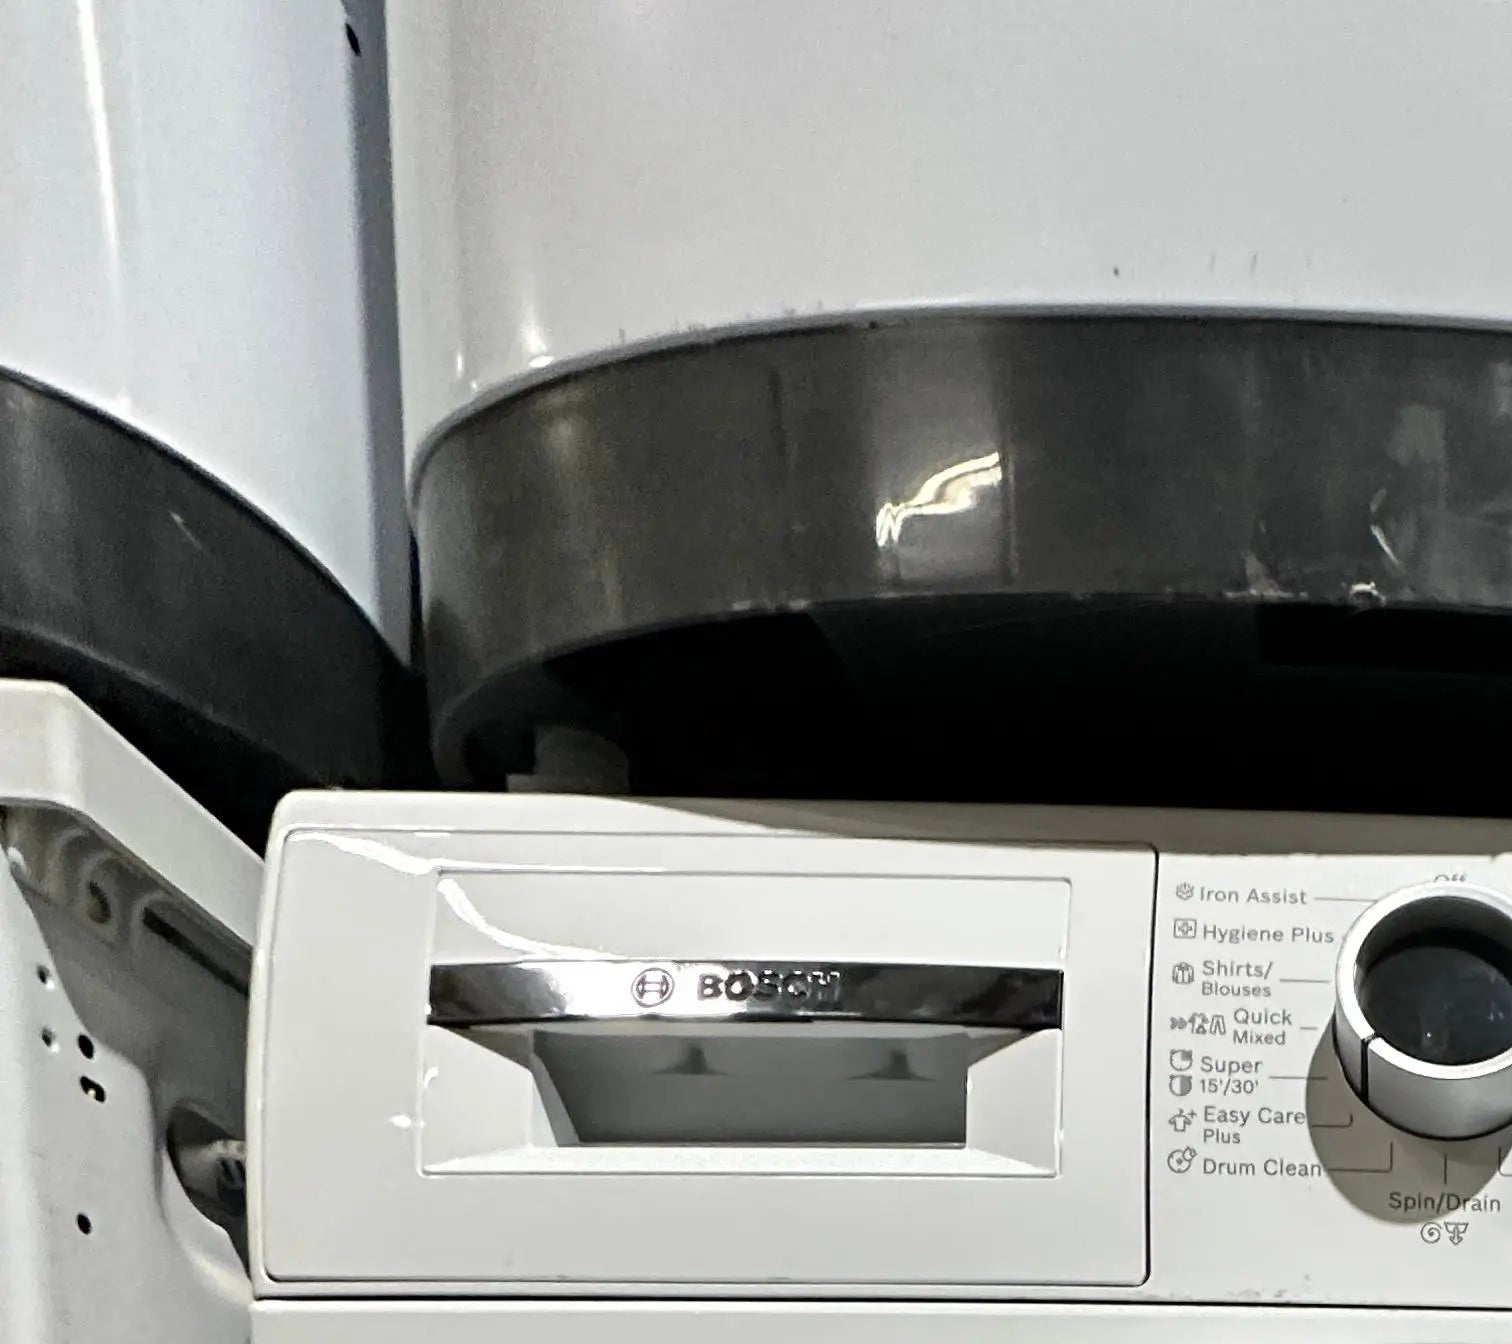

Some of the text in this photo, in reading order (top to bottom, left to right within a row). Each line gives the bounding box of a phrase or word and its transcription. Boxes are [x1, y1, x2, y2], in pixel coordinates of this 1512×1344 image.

[1200, 886, 1307, 905] Iron Assist
[1203, 924, 1335, 944] Hygiene Plus
[1202, 959, 1273, 980] Shirts/
[697, 968, 841, 1002] BOSCH
[1201, 981, 1272, 998] Blouses
[1233, 1007, 1293, 1026] Quick
[1233, 1030, 1286, 1046] Mixed
[1200, 1055, 1264, 1075] Super
[1200, 1079, 1259, 1096] 15'/30'
[1204, 1105, 1306, 1127] Easy Care
[1203, 1128, 1241, 1145] Plus
[1203, 1158, 1322, 1177] Drum Clean
[1388, 1191, 1501, 1213] Spin/Drain
